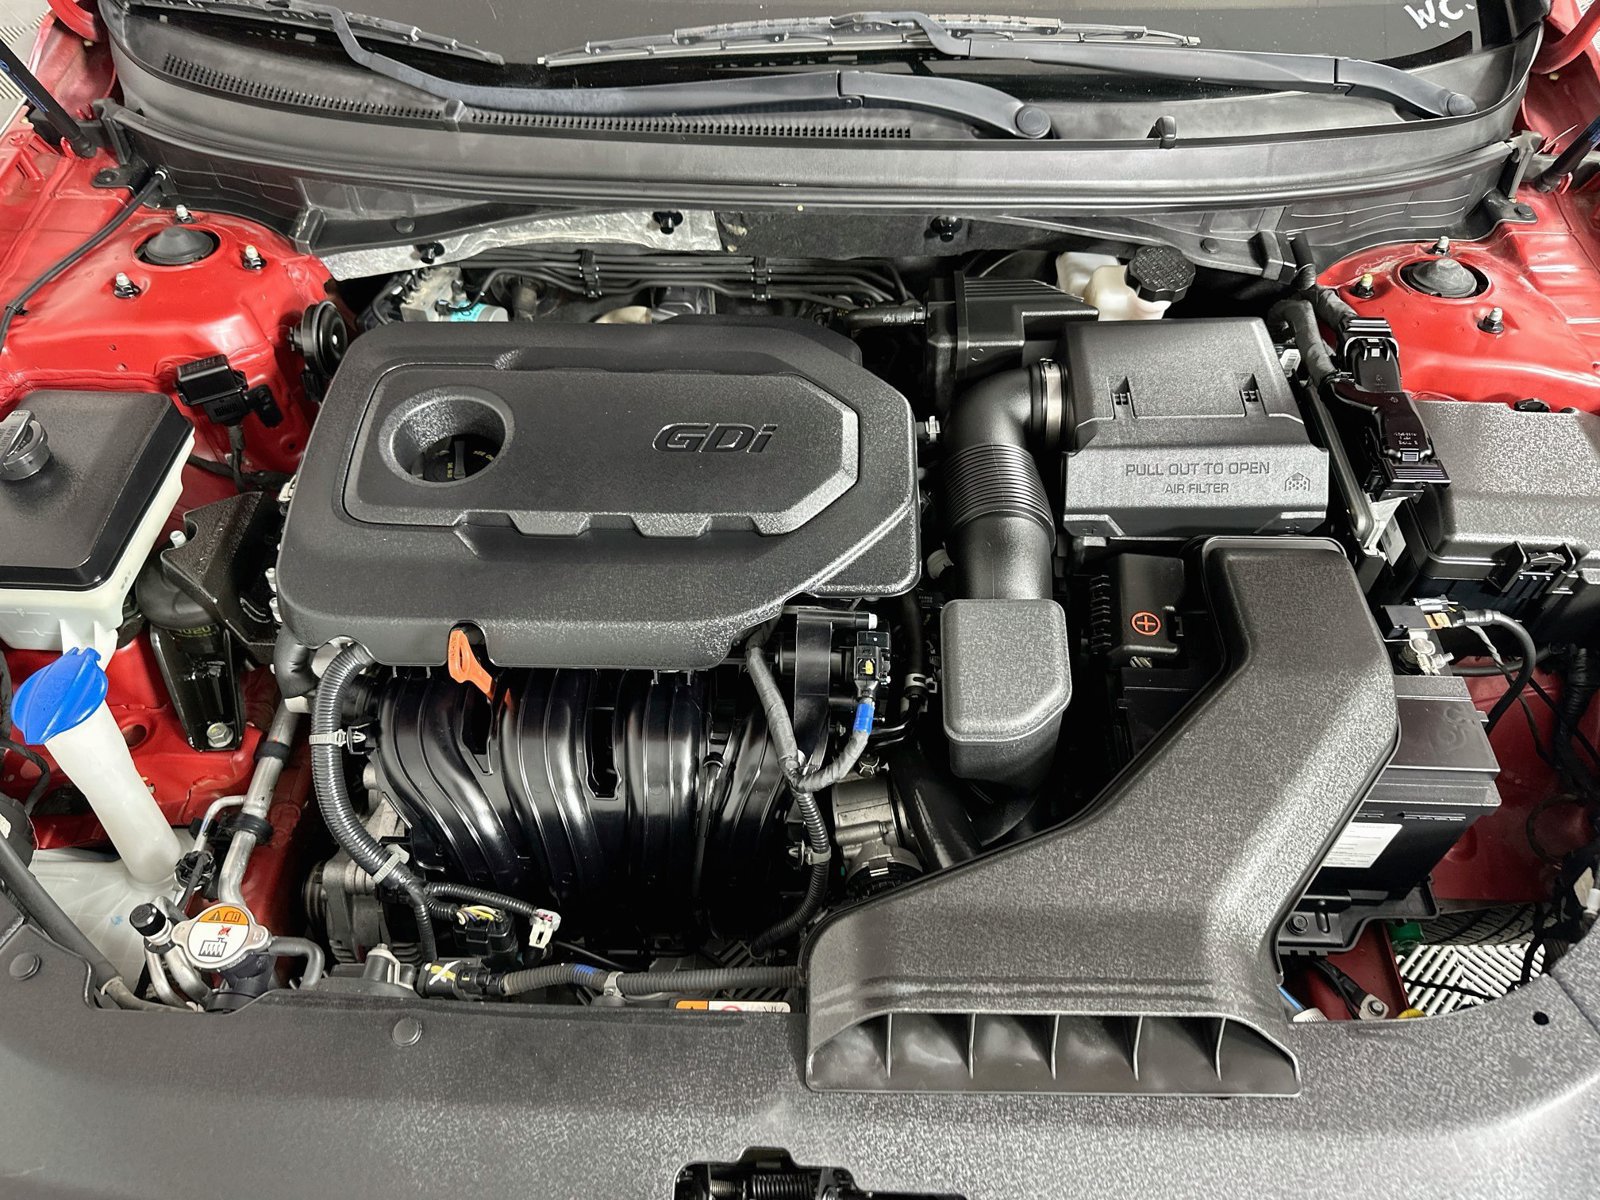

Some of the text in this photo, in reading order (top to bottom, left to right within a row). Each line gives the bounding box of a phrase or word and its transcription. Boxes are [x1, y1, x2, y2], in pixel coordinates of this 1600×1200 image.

[651, 422, 778, 453] GDi
[1125, 461, 1271, 477] PULL OUT TO OPEN
[1164, 482, 1230, 494] AIR FILTER
